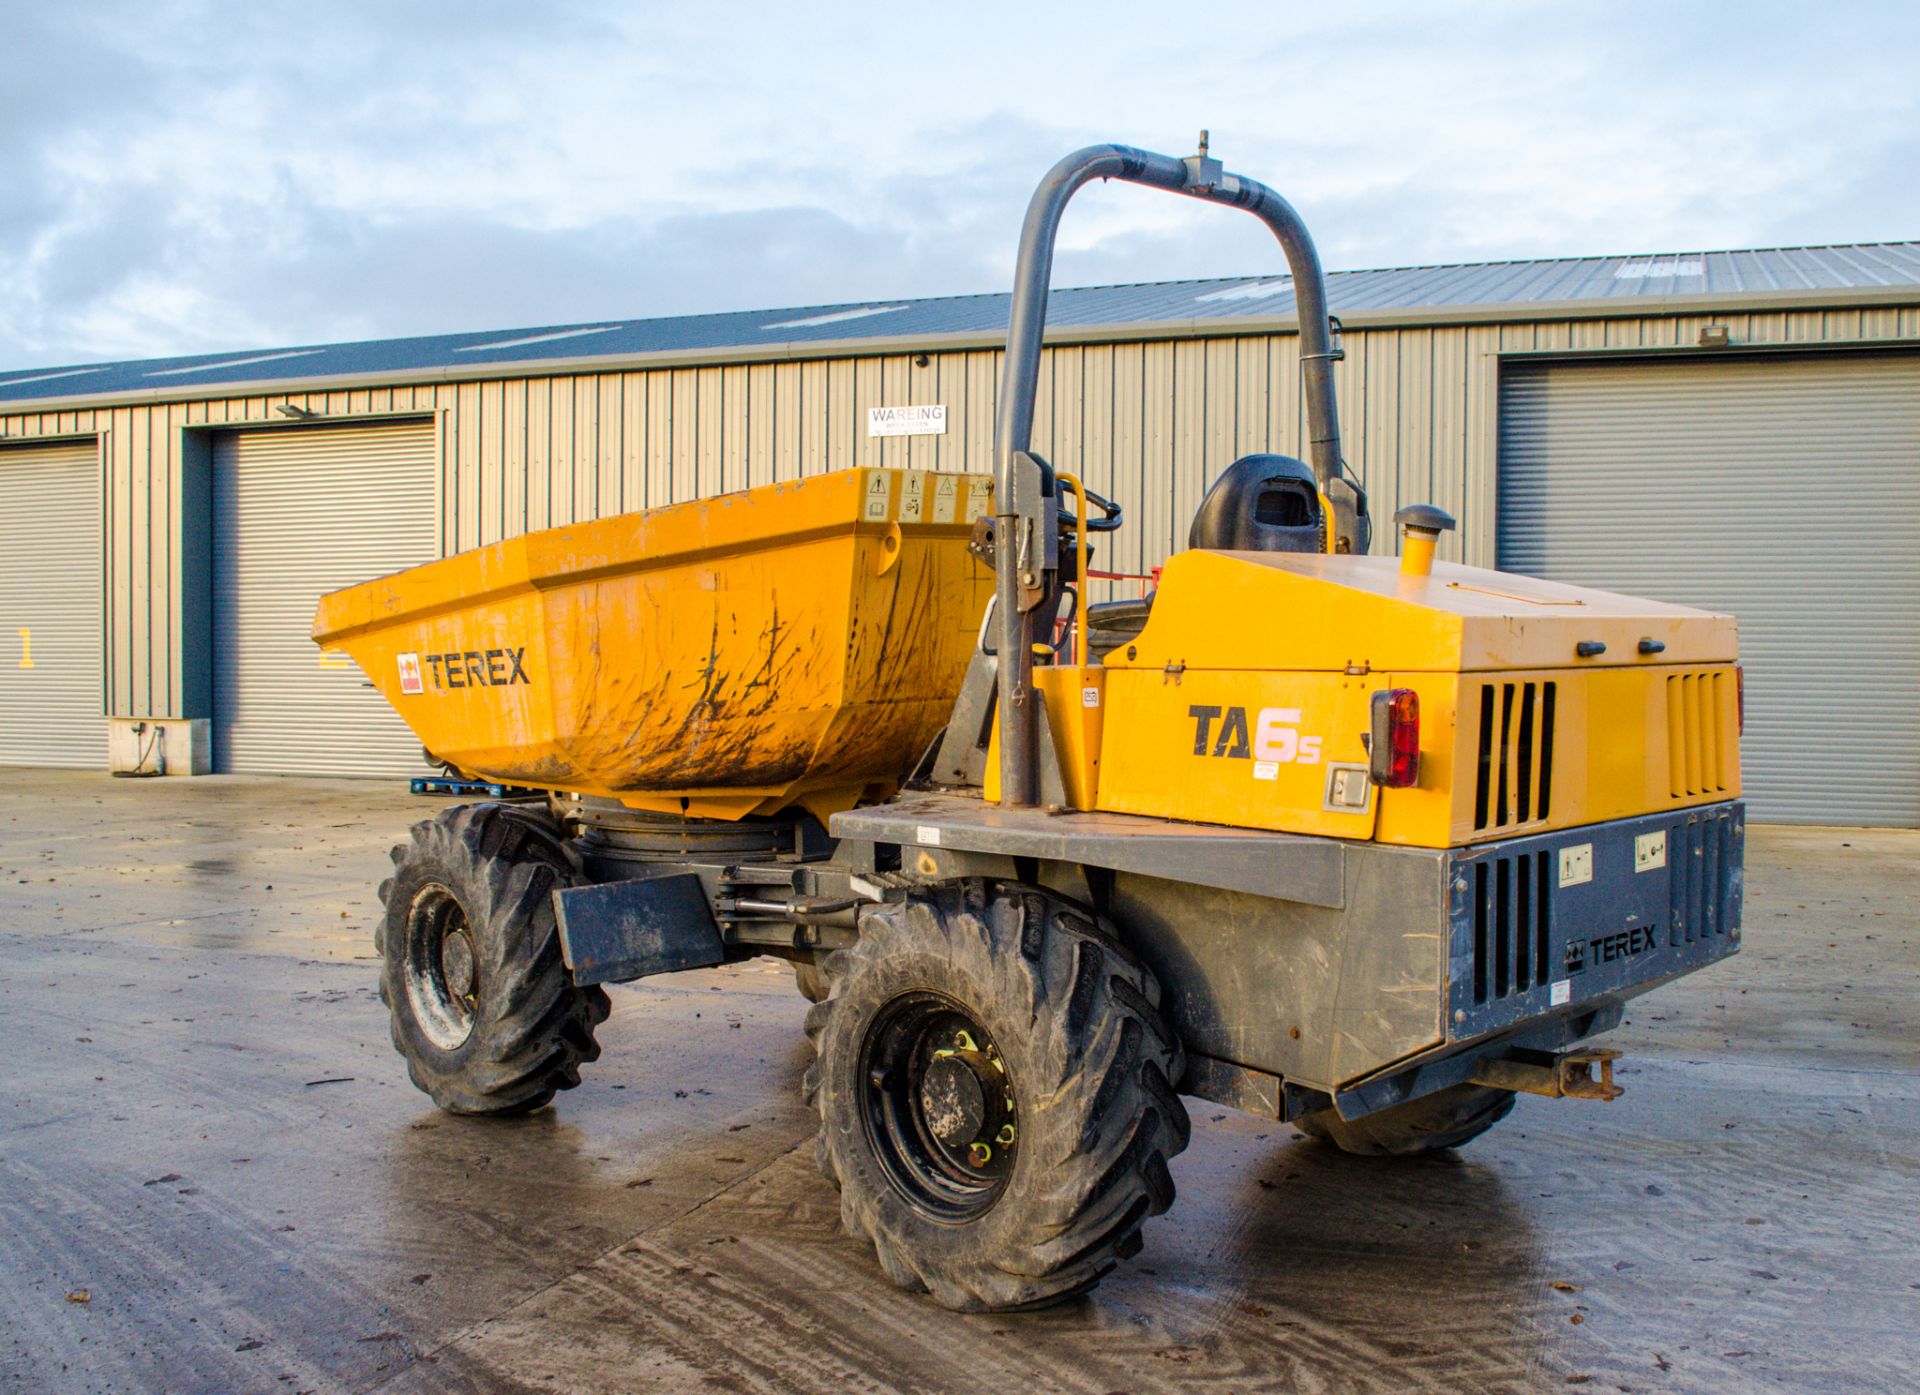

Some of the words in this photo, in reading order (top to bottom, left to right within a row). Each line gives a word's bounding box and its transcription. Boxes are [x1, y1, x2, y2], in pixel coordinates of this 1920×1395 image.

[872, 406, 942, 422] WAREING
[18, 628, 34, 668] 1
[425, 647, 530, 689] TEREX
[1590, 924, 1656, 965] TEREX
